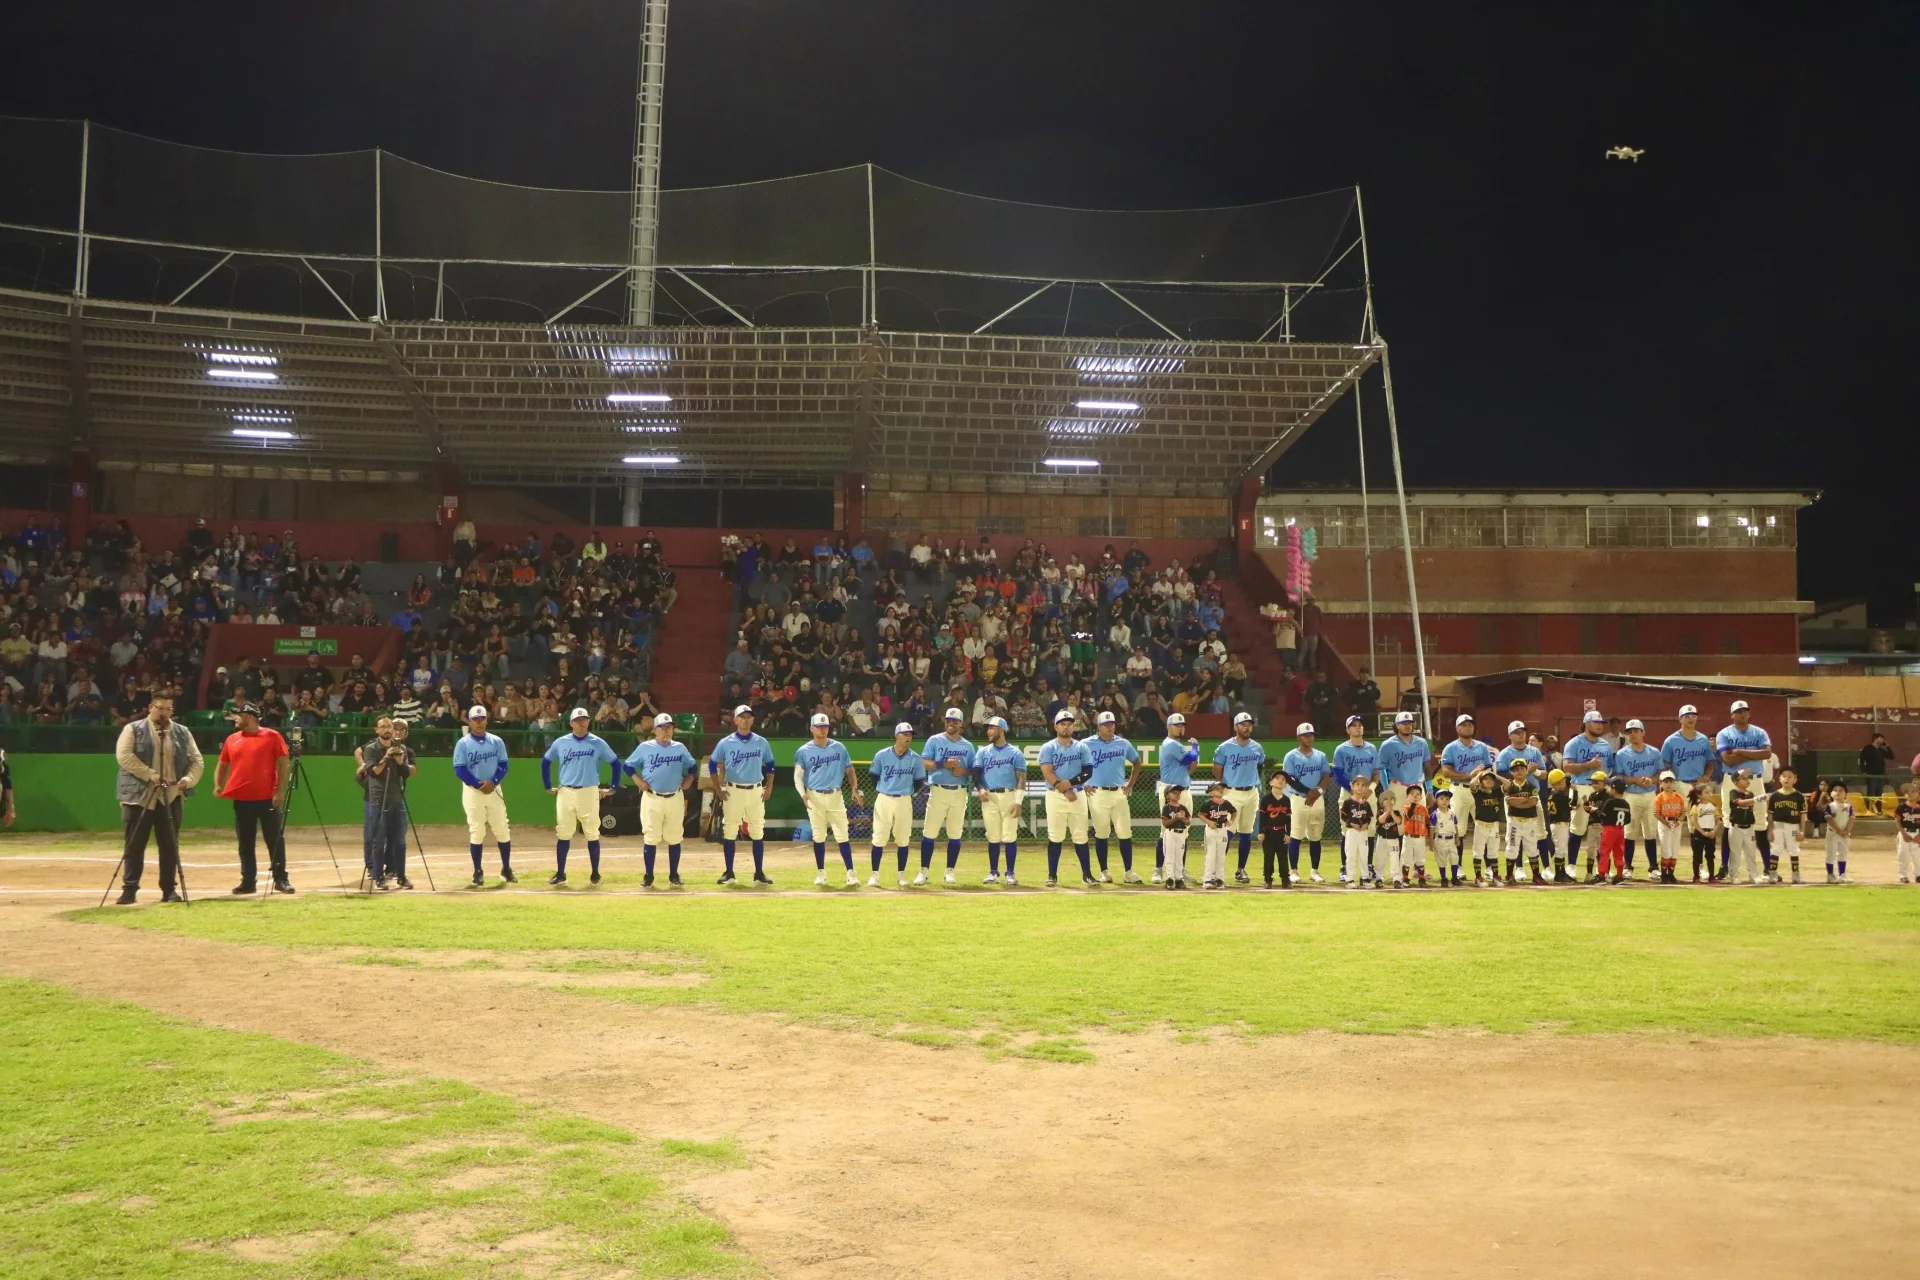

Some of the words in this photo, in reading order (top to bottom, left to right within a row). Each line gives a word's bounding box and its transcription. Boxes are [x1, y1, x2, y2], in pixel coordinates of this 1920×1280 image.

[563, 749, 594, 766] Yaquis
[650, 753, 682, 772] Yaquis
[730, 749, 761, 768] Yaquis
[810, 753, 840, 772] Yaquis
[1053, 752, 1082, 770] Yaquis
[1092, 749, 1125, 768] Yaquis
[884, 765, 914, 782] Yaquis
[1774, 801, 1797, 809] POTROS
[1616, 811, 1624, 826] 8
